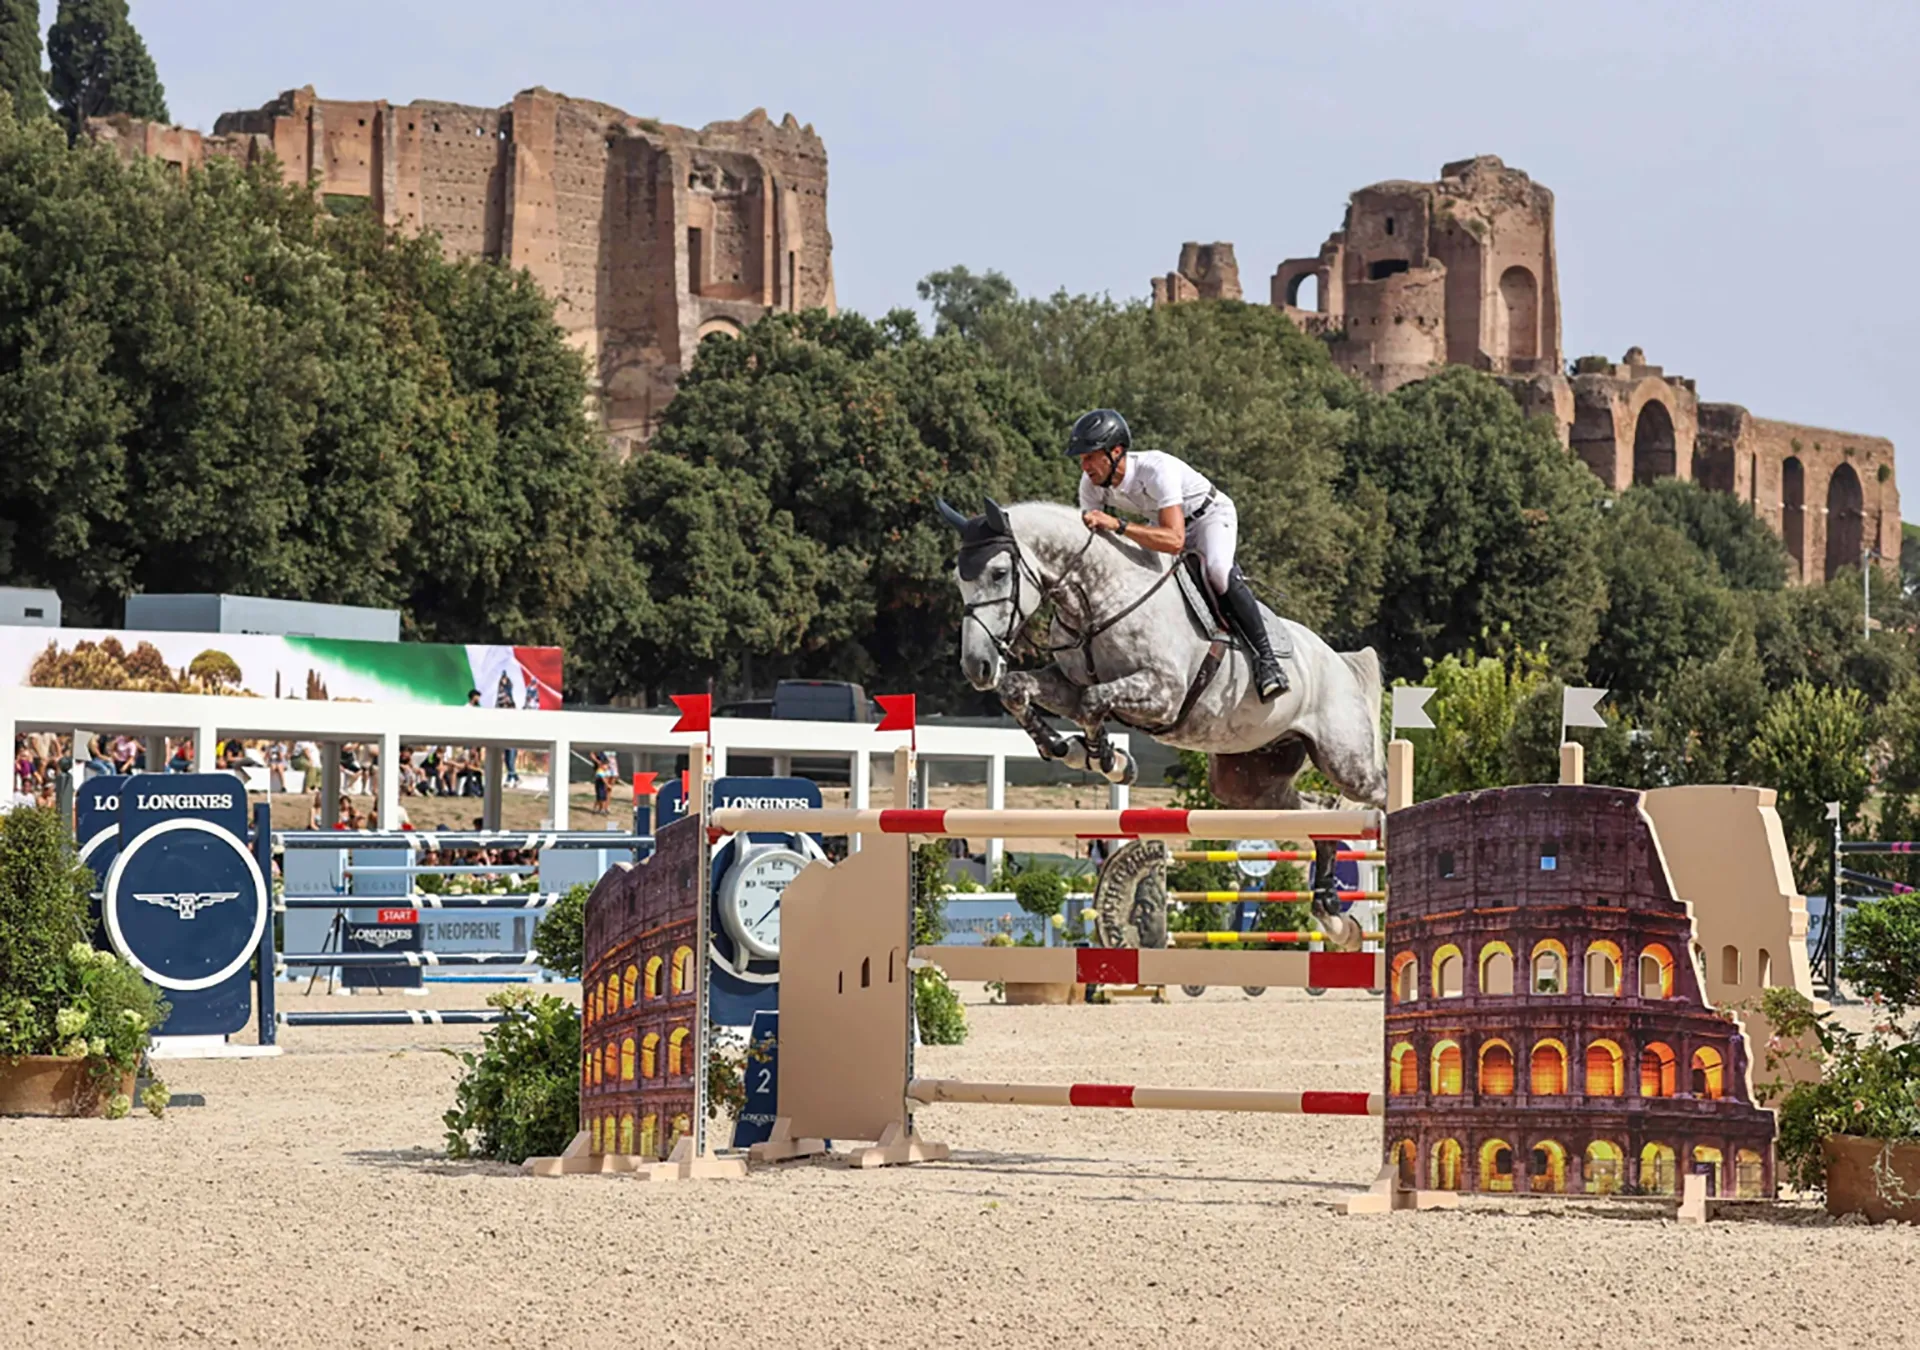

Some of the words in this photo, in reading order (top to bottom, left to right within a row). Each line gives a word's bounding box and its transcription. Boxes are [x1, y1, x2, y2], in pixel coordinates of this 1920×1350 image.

[137, 794, 233, 810] LONGINES
[722, 796, 810, 809] LONGINES
[383, 909, 412, 921] START
[437, 922, 502, 940] NEOPRENE
[756, 1068, 771, 1093] 2
